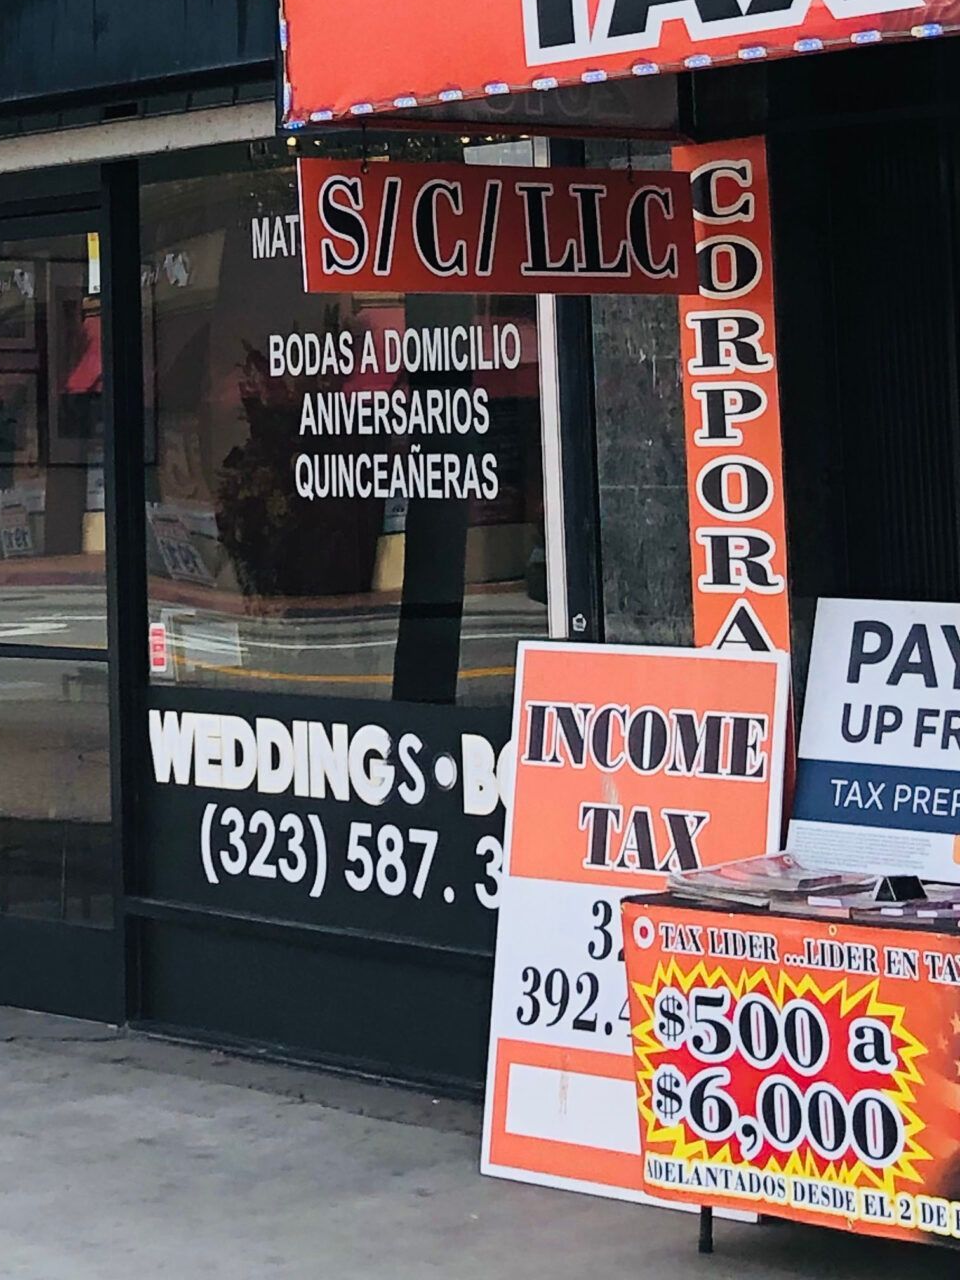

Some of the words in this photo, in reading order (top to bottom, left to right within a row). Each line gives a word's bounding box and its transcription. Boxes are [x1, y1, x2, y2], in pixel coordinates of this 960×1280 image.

[318, 175, 678, 280] S/C/LLC
[269, 330, 354, 377] BODAS
[360, 340, 379, 375] A
[385, 323, 521, 372] DOMICILIO
[299, 388, 490, 435] ANIVERSARIOS
[295, 444, 500, 500] QUINCEAÑERAS
[847, 620, 960, 690] PAY
[523, 704, 766, 778] INCOME
[841, 703, 903, 745] UP
[149, 709, 426, 806] WEDDINGS
[831, 779, 886, 811] TAX
[201, 803, 328, 898] (323)
[581, 805, 708, 872] TAX
[588, 900, 625, 961] 3
[661, 926, 703, 962] TAX
[709, 932, 778, 963] LIDER
[887, 949, 918, 980] EN
[926, 953, 960, 984] TA
[659, 993, 829, 1069] $500
[853, 1024, 892, 1066] a
[655, 1072, 900, 1162] $6,000
[793, 1181, 856, 1213] DESDE
[864, 1194, 892, 1218] EL
[899, 1198, 912, 1221] 2
[921, 1202, 948, 1228] DE
